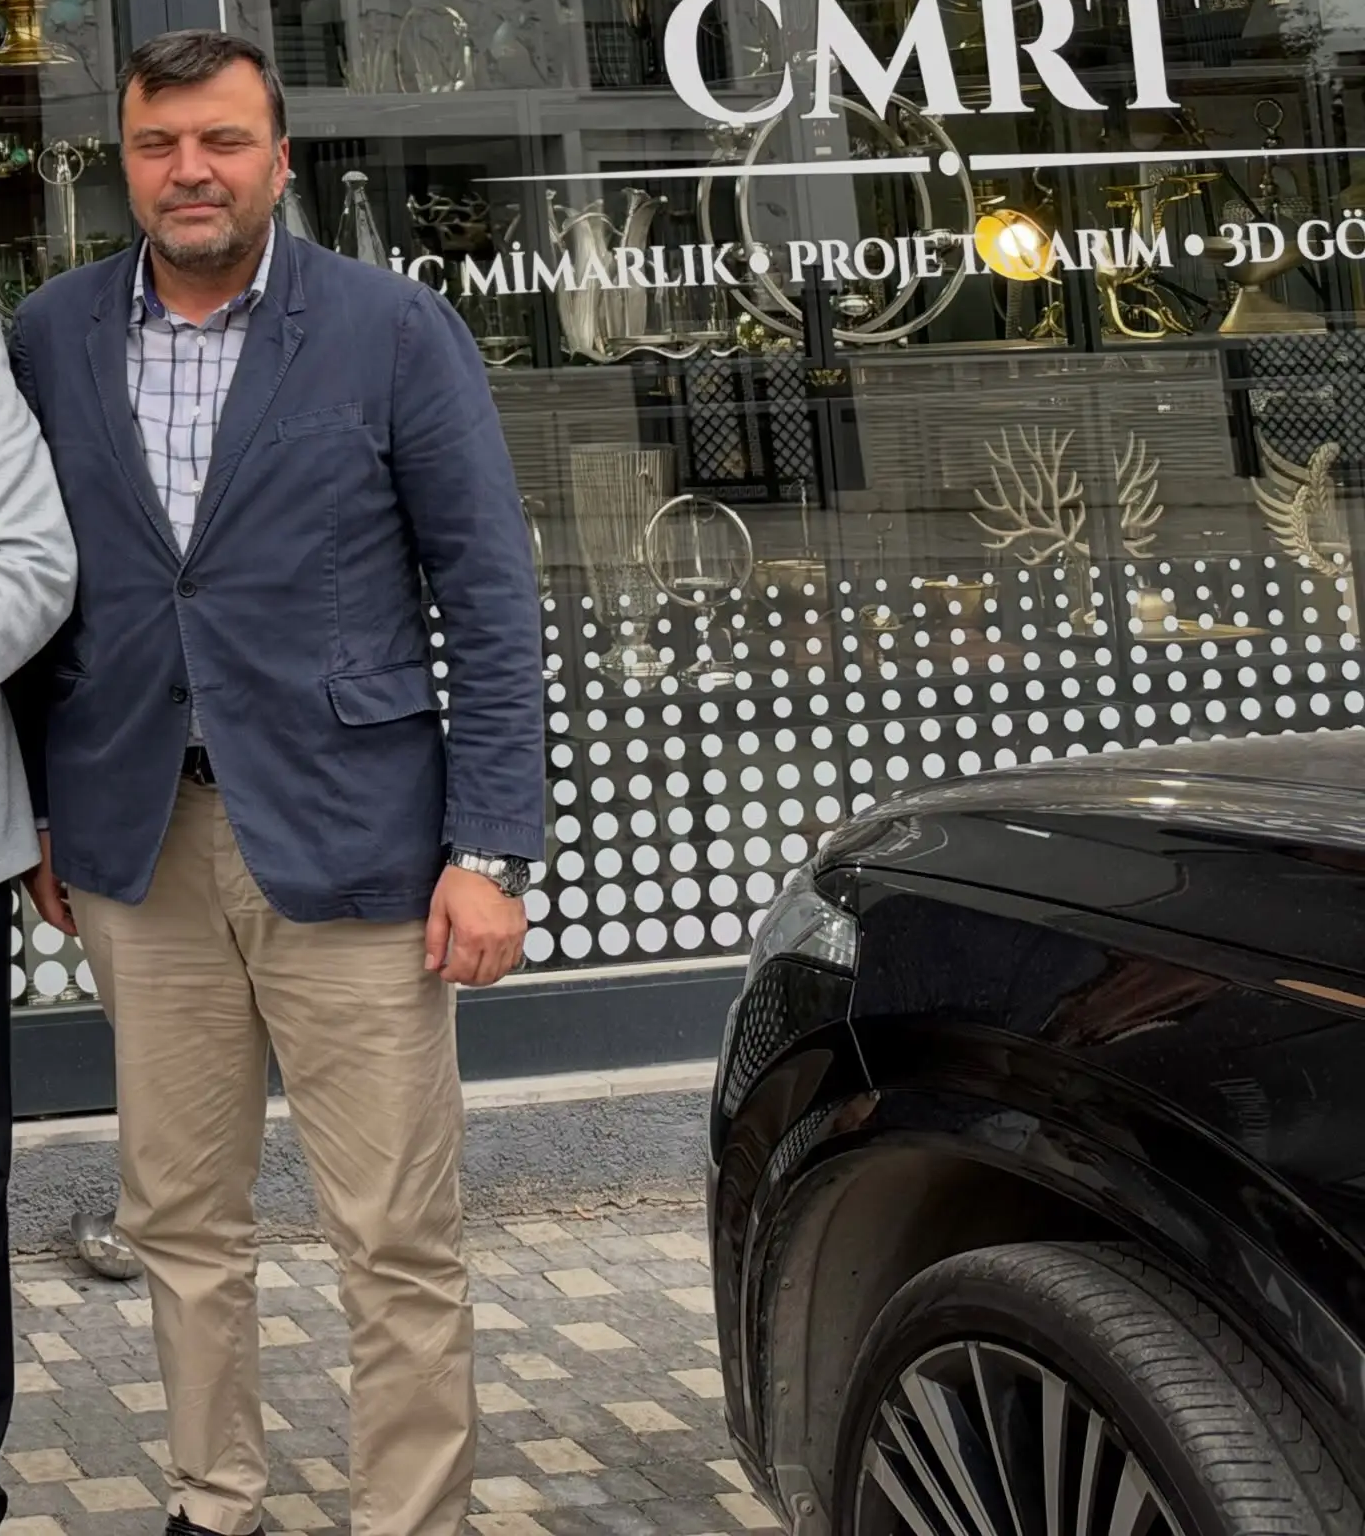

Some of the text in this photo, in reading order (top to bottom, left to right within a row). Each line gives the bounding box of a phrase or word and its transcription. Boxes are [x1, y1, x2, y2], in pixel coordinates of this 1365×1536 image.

[460, 241, 740, 297] MİMARLIK
[785, 236, 944, 290] PROJE
[1219, 221, 1286, 268] 3D
